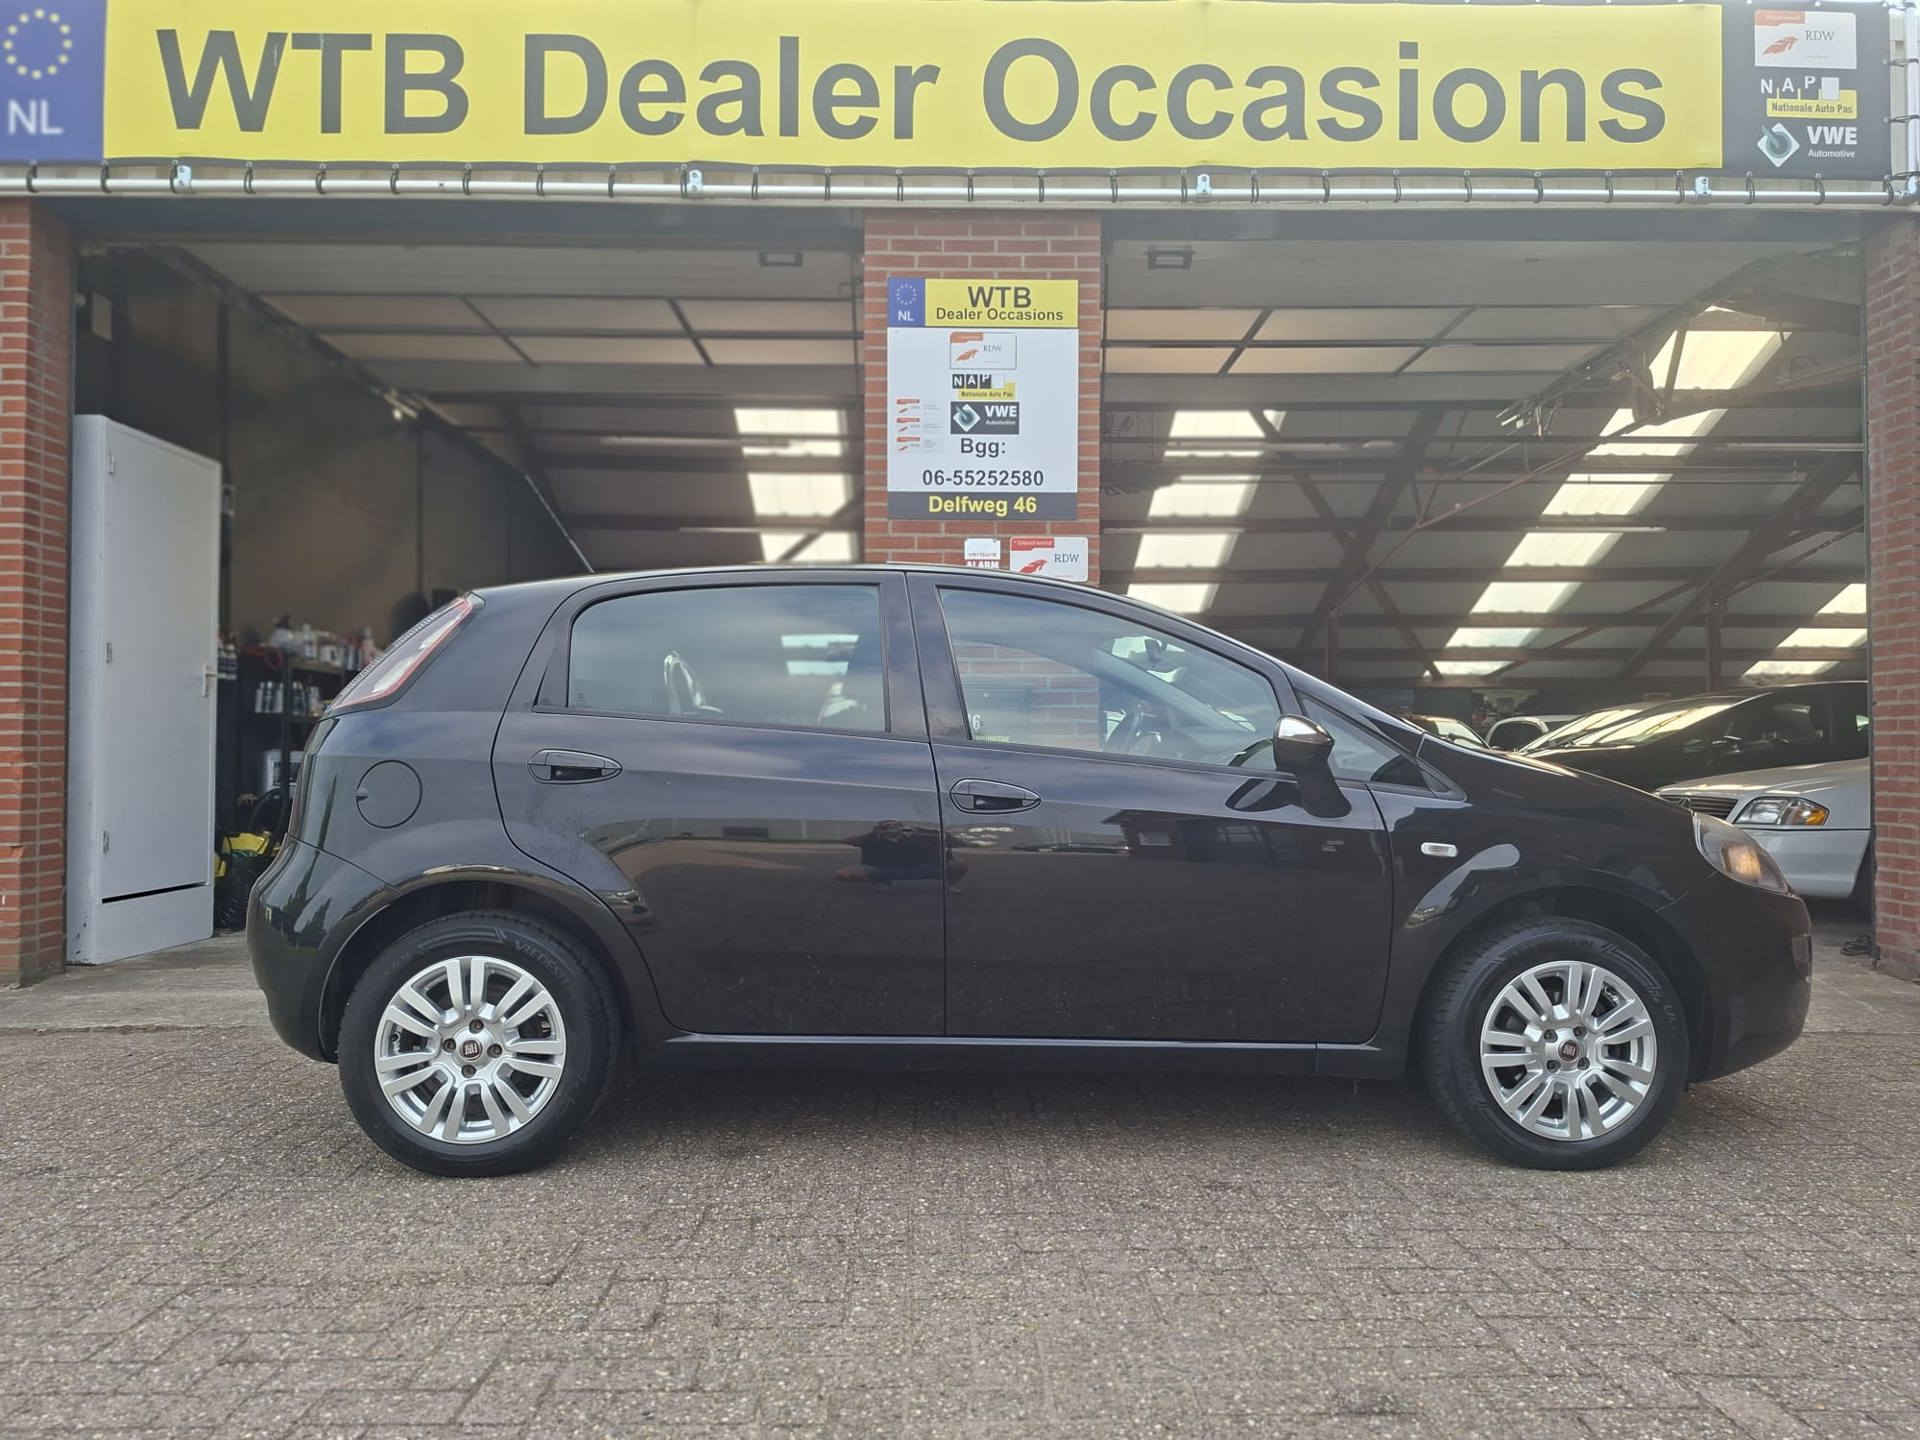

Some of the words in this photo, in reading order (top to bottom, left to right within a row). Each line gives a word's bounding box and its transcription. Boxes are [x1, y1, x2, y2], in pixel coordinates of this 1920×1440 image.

[1805, 30, 1835, 41] RDW
[156, 29, 469, 134] WTB
[523, 33, 941, 140] Dealer
[982, 38, 1666, 142] Occasions
[1771, 102, 1813, 113] Nationale
[1815, 104, 1835, 113] Auto
[1837, 105, 1853, 114] Pas
[8, 101, 63, 134] NL
[1806, 126, 1857, 145] VWE
[1808, 149, 1855, 158] Automotive
[967, 286, 1032, 308] WTB
[898, 310, 914, 321] NL
[936, 308, 981, 320] Dealer
[987, 308, 1063, 321] Occasions
[983, 344, 1003, 352] RDW
[984, 405, 1017, 417] VWE
[960, 438, 1006, 458] Bgg:
[922, 469, 1044, 486] 06-55252580
[928, 496, 1008, 517] Delfweg
[1013, 497, 1037, 513] 46
[1054, 553, 1080, 563] RDW
[966, 561, 999, 569] ALARM
